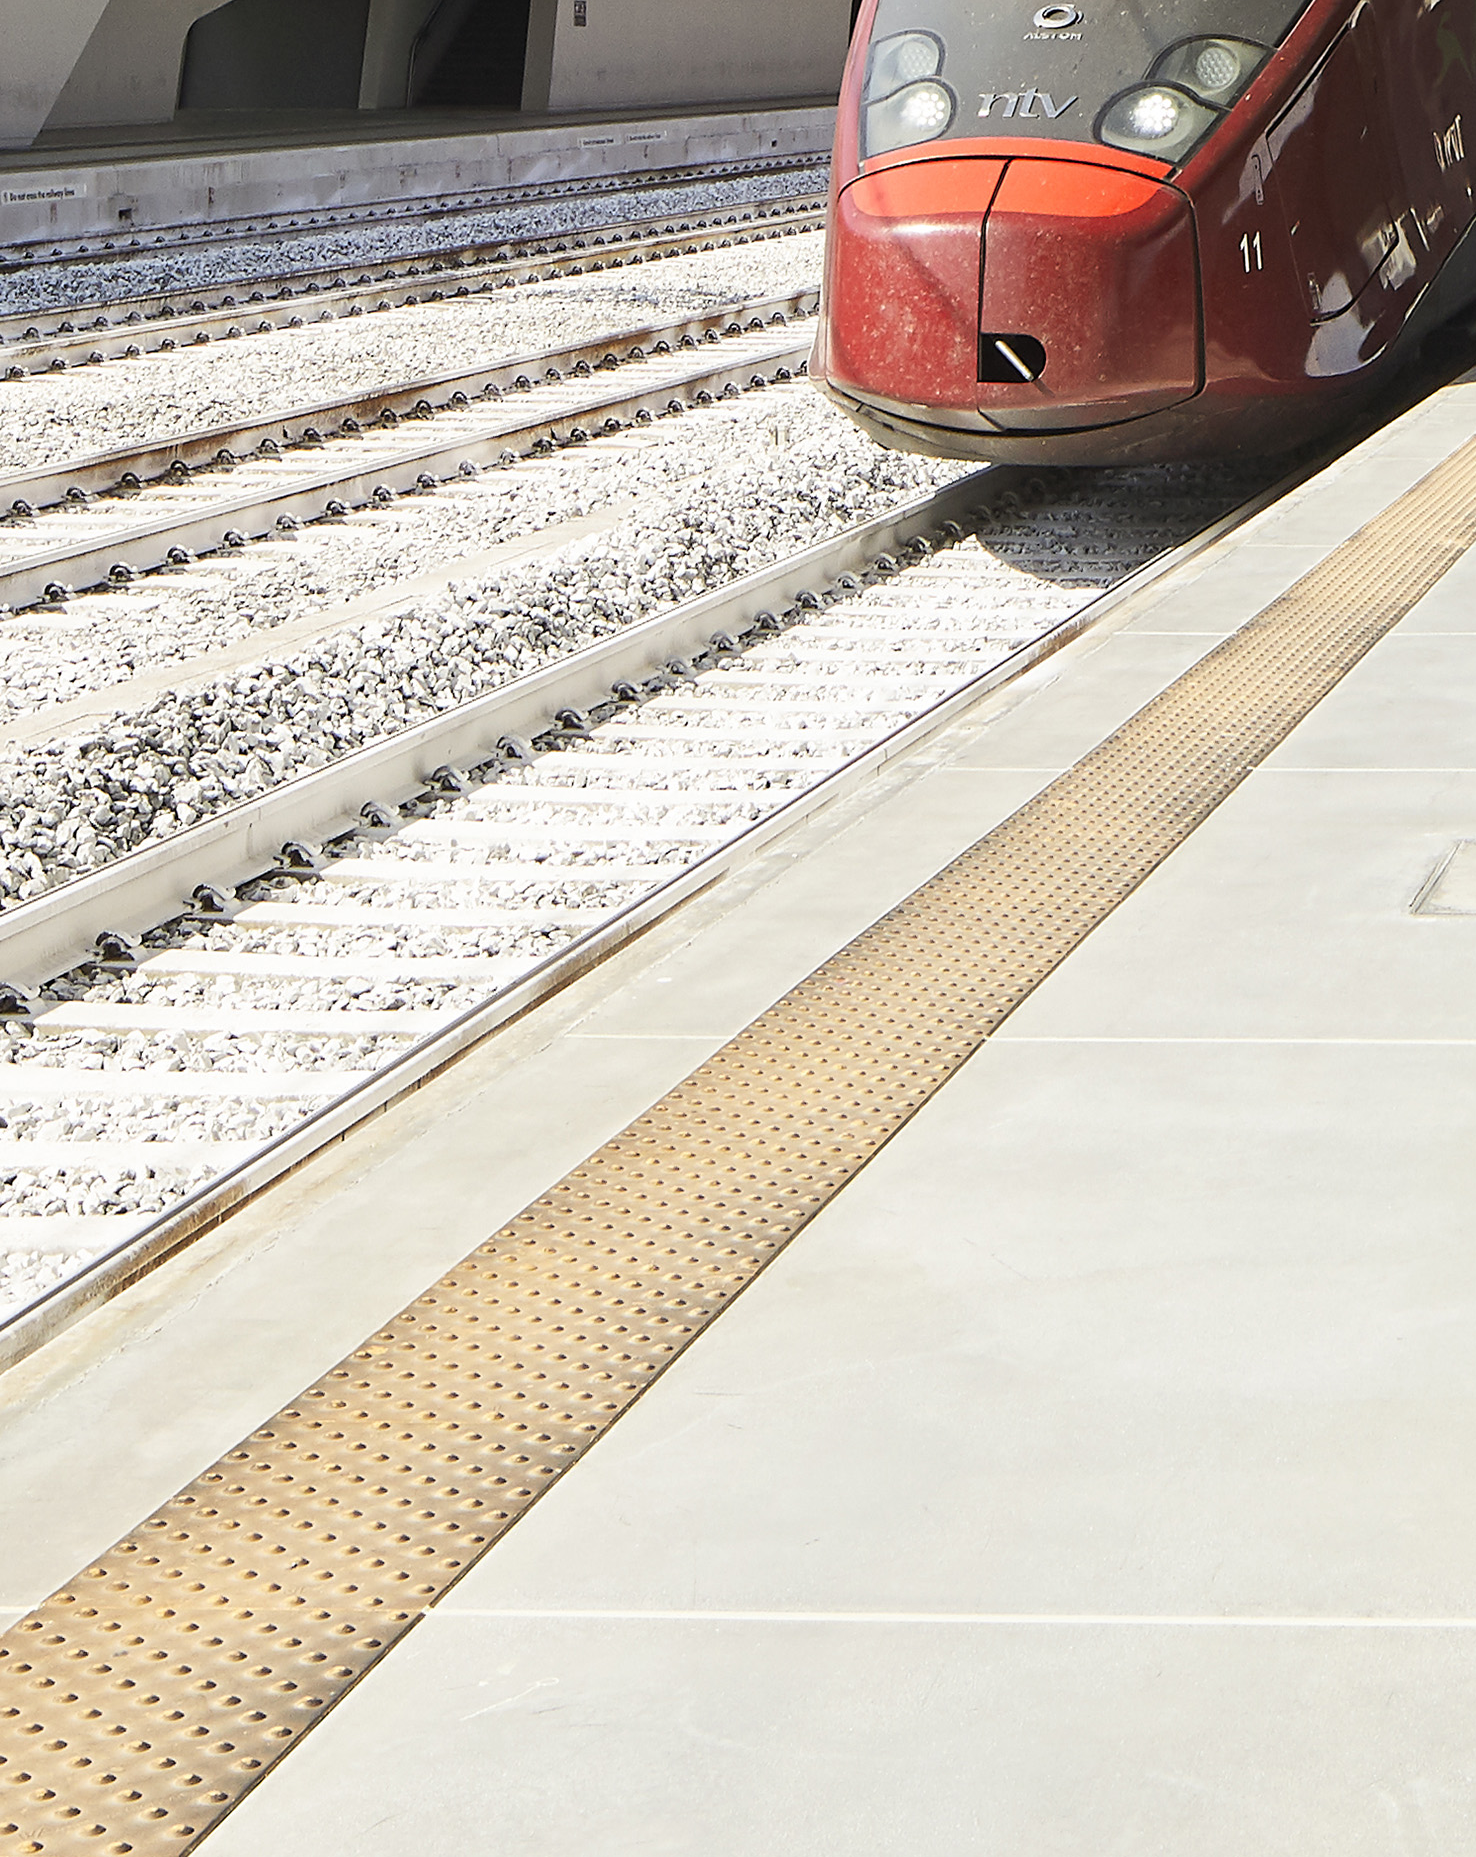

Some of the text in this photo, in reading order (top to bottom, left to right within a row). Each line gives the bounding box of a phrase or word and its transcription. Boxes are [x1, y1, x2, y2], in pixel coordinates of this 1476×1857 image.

[1023, 31, 1083, 41] ALSTOM
[977, 87, 1078, 119] ntv
[1239, 231, 1263, 274] 11
